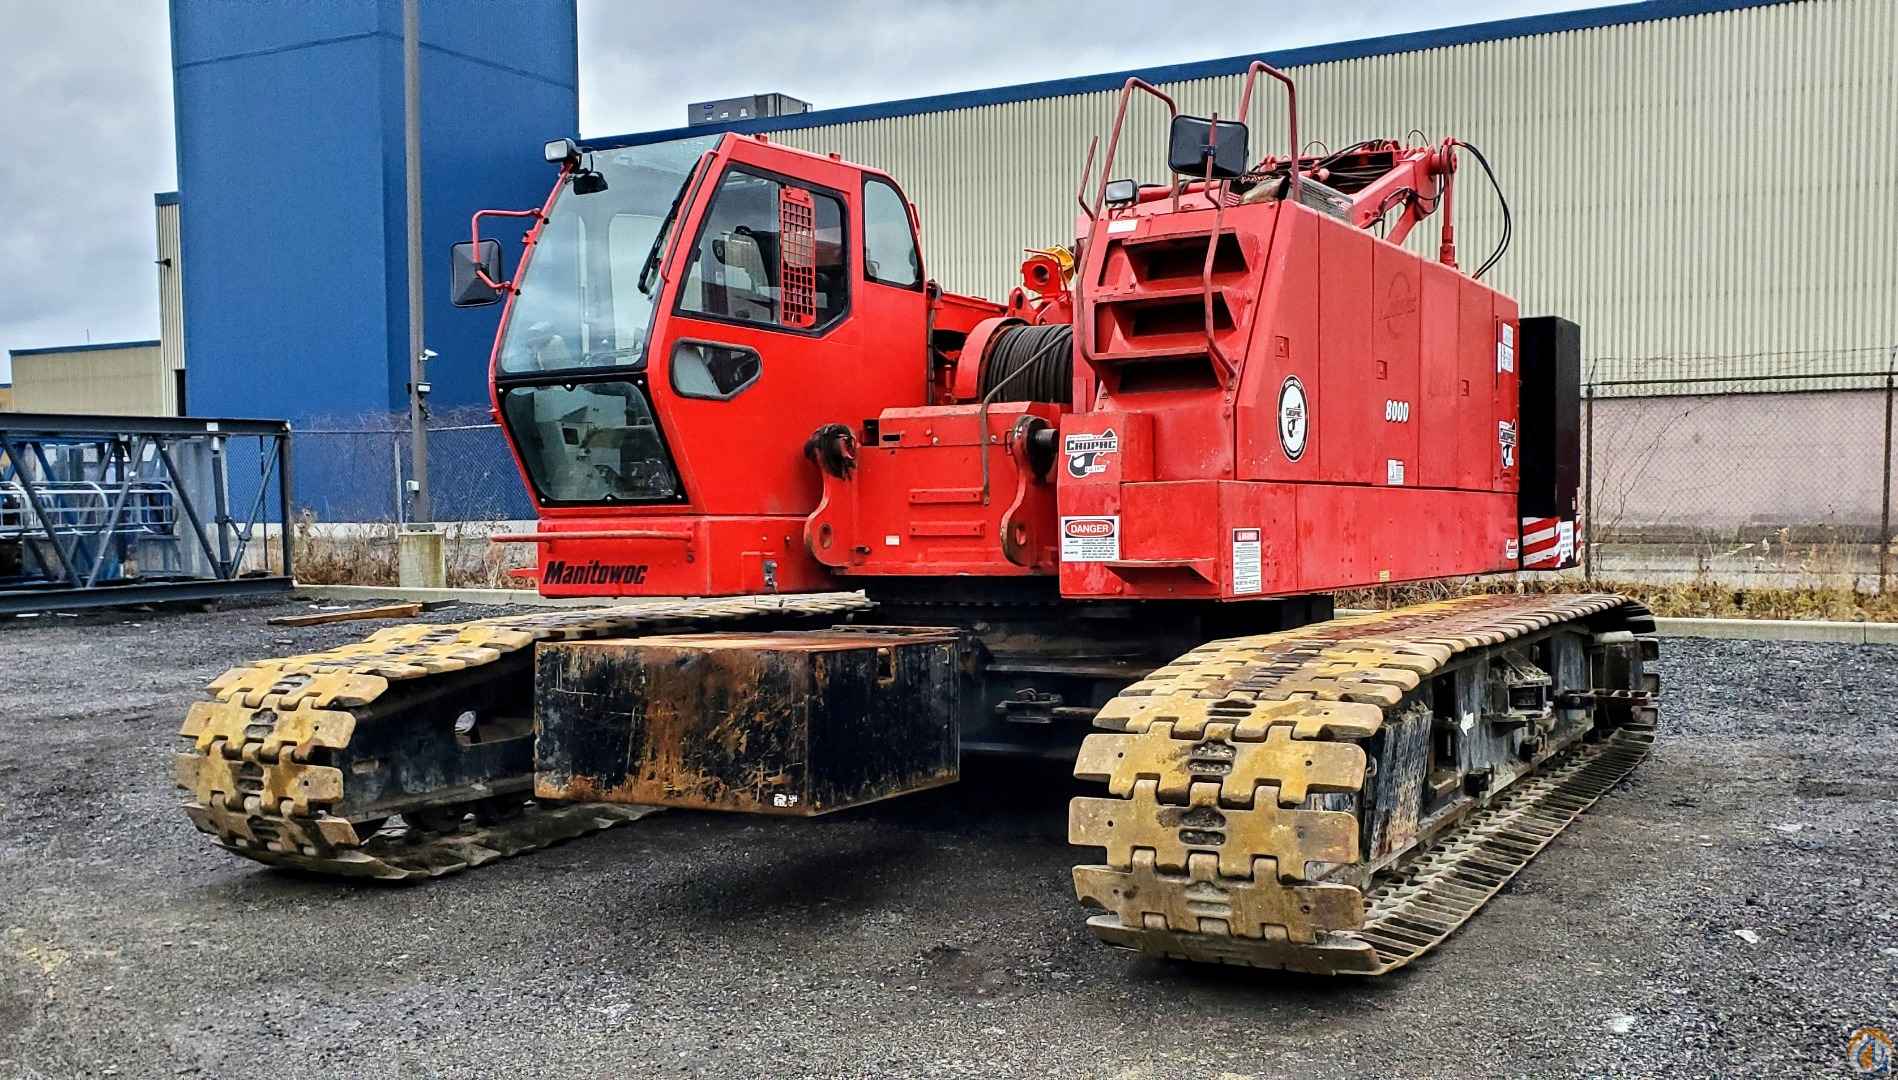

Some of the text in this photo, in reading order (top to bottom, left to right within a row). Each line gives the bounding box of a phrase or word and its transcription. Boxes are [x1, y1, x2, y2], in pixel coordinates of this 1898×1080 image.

[1385, 399, 1409, 422] 8000
[1070, 524, 1109, 533] DANGER
[543, 560, 648, 584] Manitowoc
